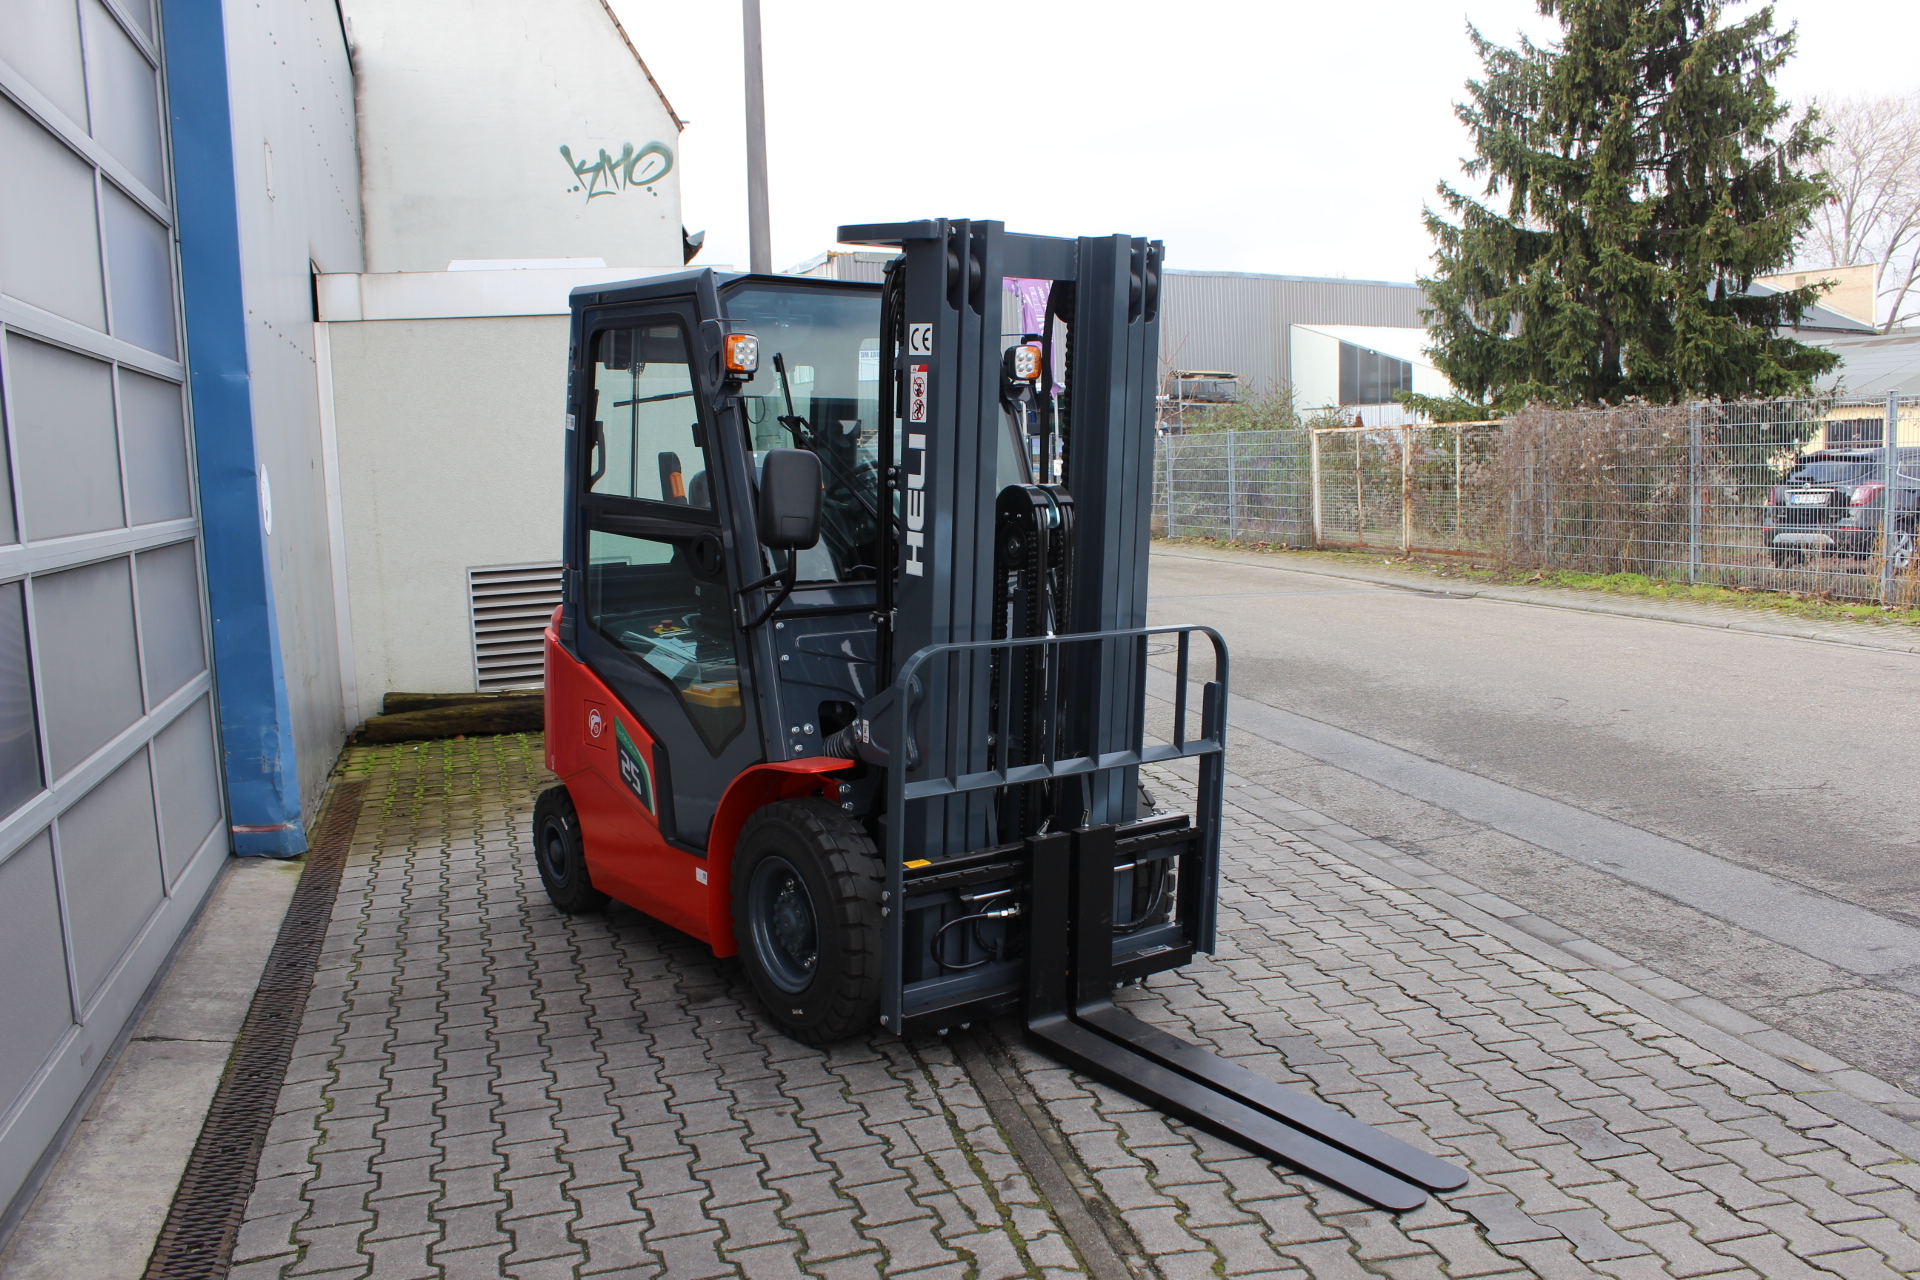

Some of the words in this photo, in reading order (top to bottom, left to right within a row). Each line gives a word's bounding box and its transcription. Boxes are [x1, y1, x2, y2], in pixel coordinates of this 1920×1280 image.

[911, 327, 931, 351] CE
[906, 433, 926, 577] HELI
[620, 749, 642, 795] 25
